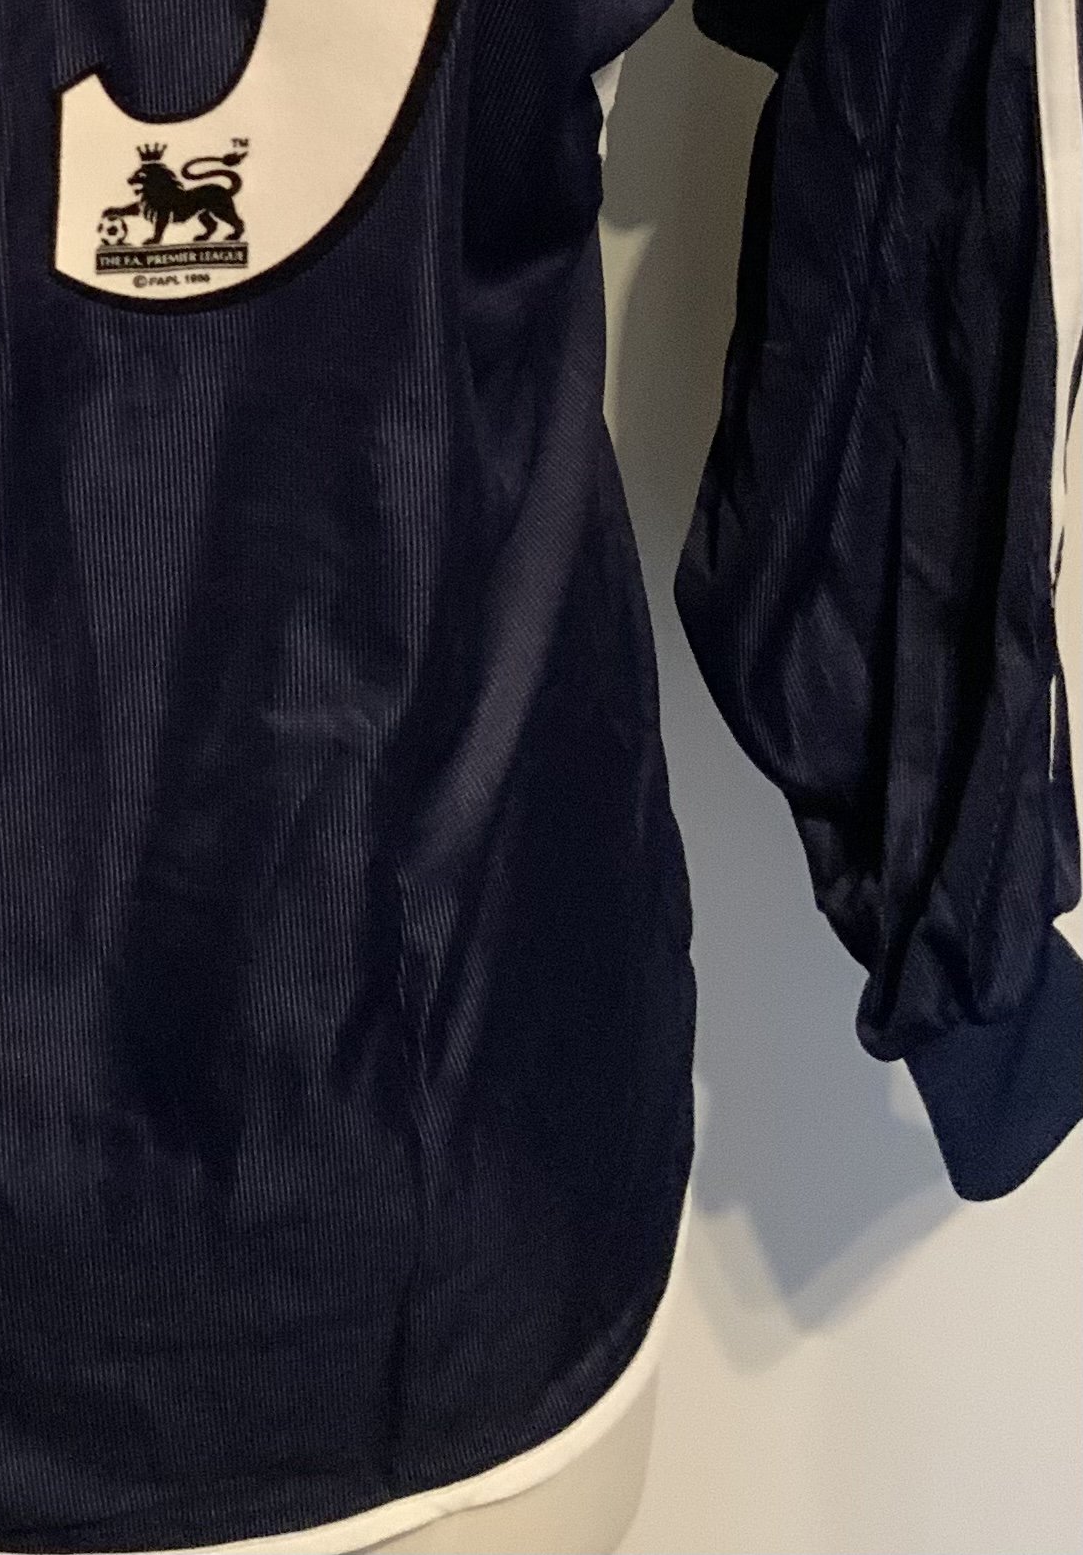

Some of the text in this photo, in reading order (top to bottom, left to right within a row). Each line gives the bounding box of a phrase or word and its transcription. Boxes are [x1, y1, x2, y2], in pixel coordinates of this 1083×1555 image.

[100, 255, 122, 266] THE
[147, 250, 197, 265] PREMIER
[199, 249, 244, 263] LEAGUE
